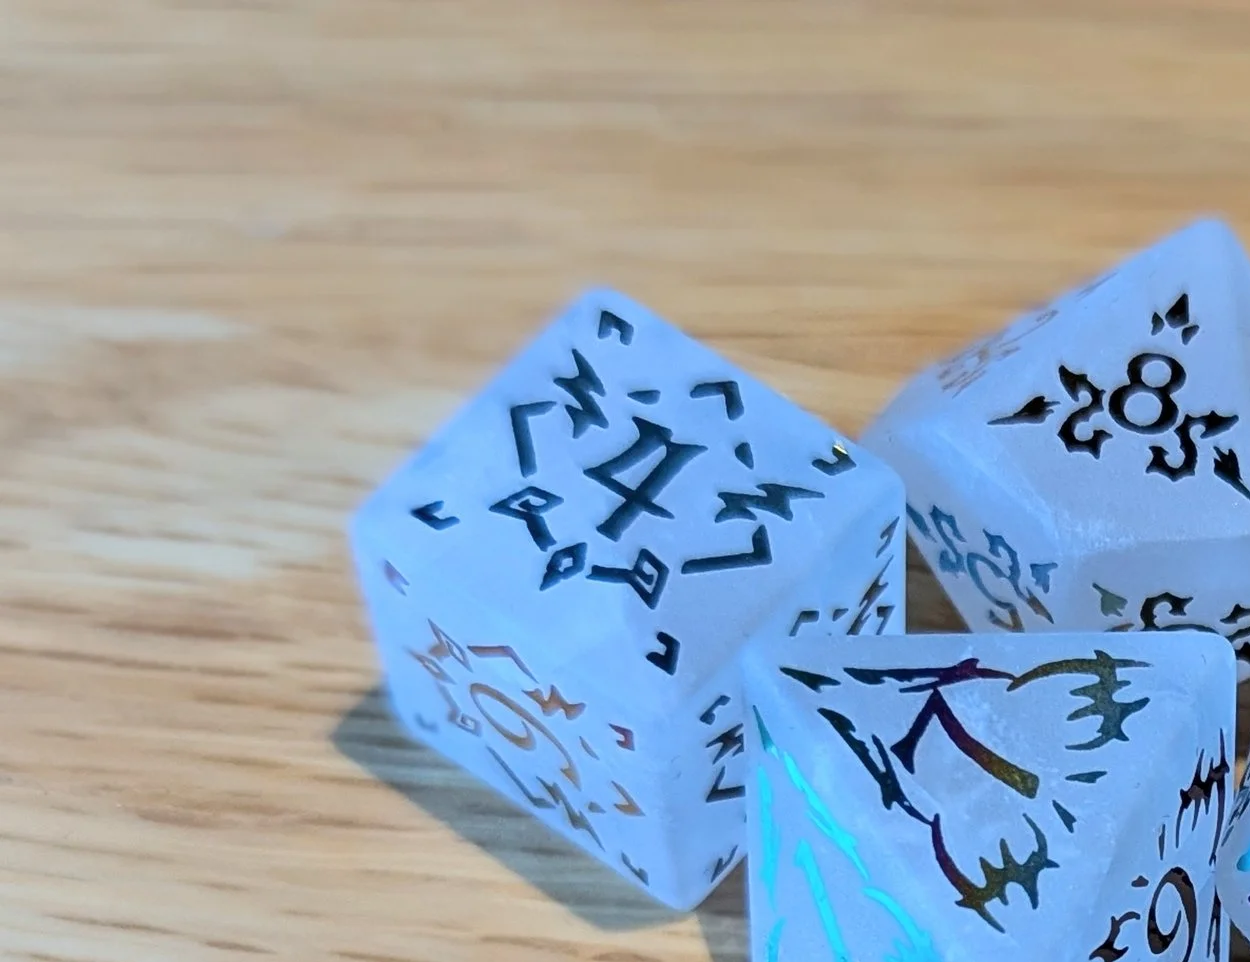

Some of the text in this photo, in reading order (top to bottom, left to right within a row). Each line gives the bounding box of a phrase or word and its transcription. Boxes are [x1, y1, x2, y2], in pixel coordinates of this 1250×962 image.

[1108, 353, 1187, 435] 8
[583, 415, 709, 542] 4
[890, 687, 1040, 799] 7
